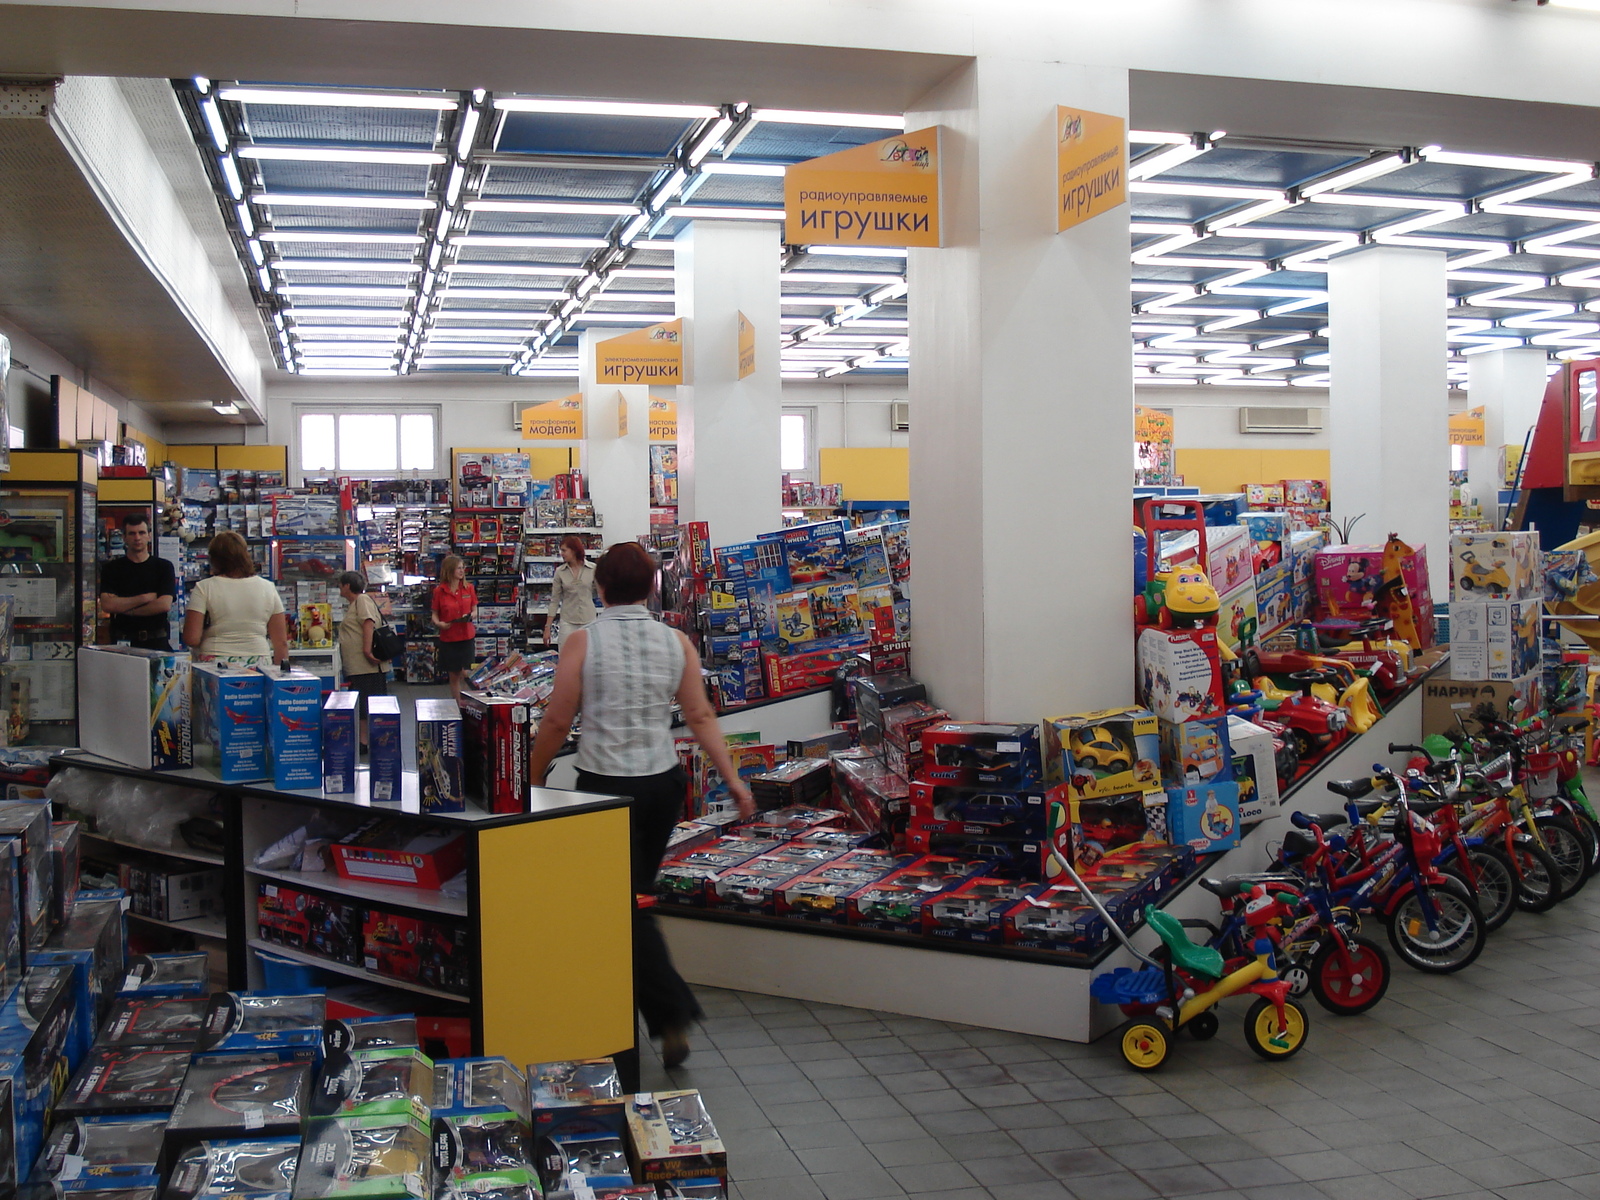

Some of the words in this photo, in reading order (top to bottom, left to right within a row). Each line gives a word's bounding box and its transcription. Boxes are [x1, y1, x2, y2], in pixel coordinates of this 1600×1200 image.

[1062, 145, 1119, 187] радиоуправляемые
[800, 190, 928, 204] радиоуправляемые
[1062, 165, 1120, 217] игрушки
[800, 209, 929, 239] игрушки
[604, 364, 679, 382] игрушки
[529, 425, 576, 436] модели
[649, 427, 677, 438] игры
[1449, 433, 1482, 444] грушки
[1427, 685, 1478, 699] HAPPY
[1243, 808, 1262, 818] LOCO
[664, 1160, 681, 1170] VW
[646, 1166, 717, 1180] Race-Touareg
